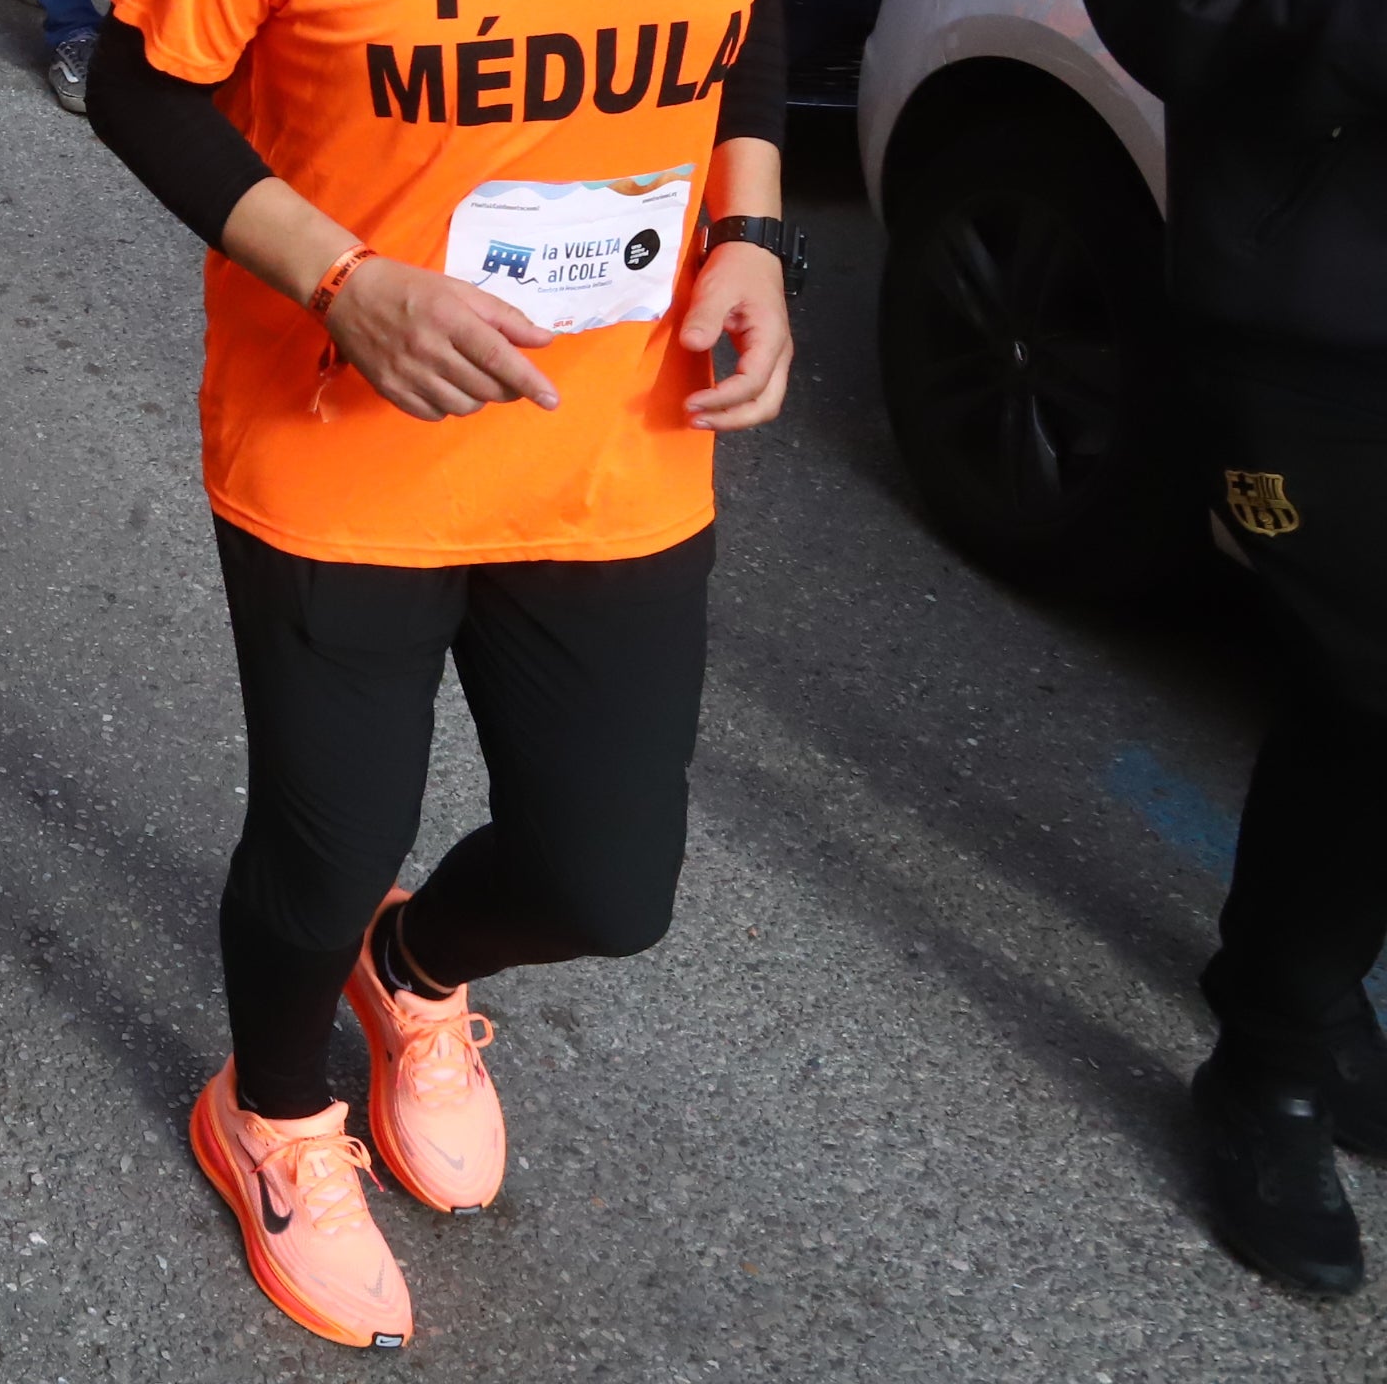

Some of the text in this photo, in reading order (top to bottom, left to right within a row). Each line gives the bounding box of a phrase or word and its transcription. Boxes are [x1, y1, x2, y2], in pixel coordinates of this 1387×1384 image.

[366, 6, 744, 126] MÉDULA
[542, 244, 557, 260] la
[565, 238, 624, 259] VUELTA
[548, 262, 608, 283] al COLE
